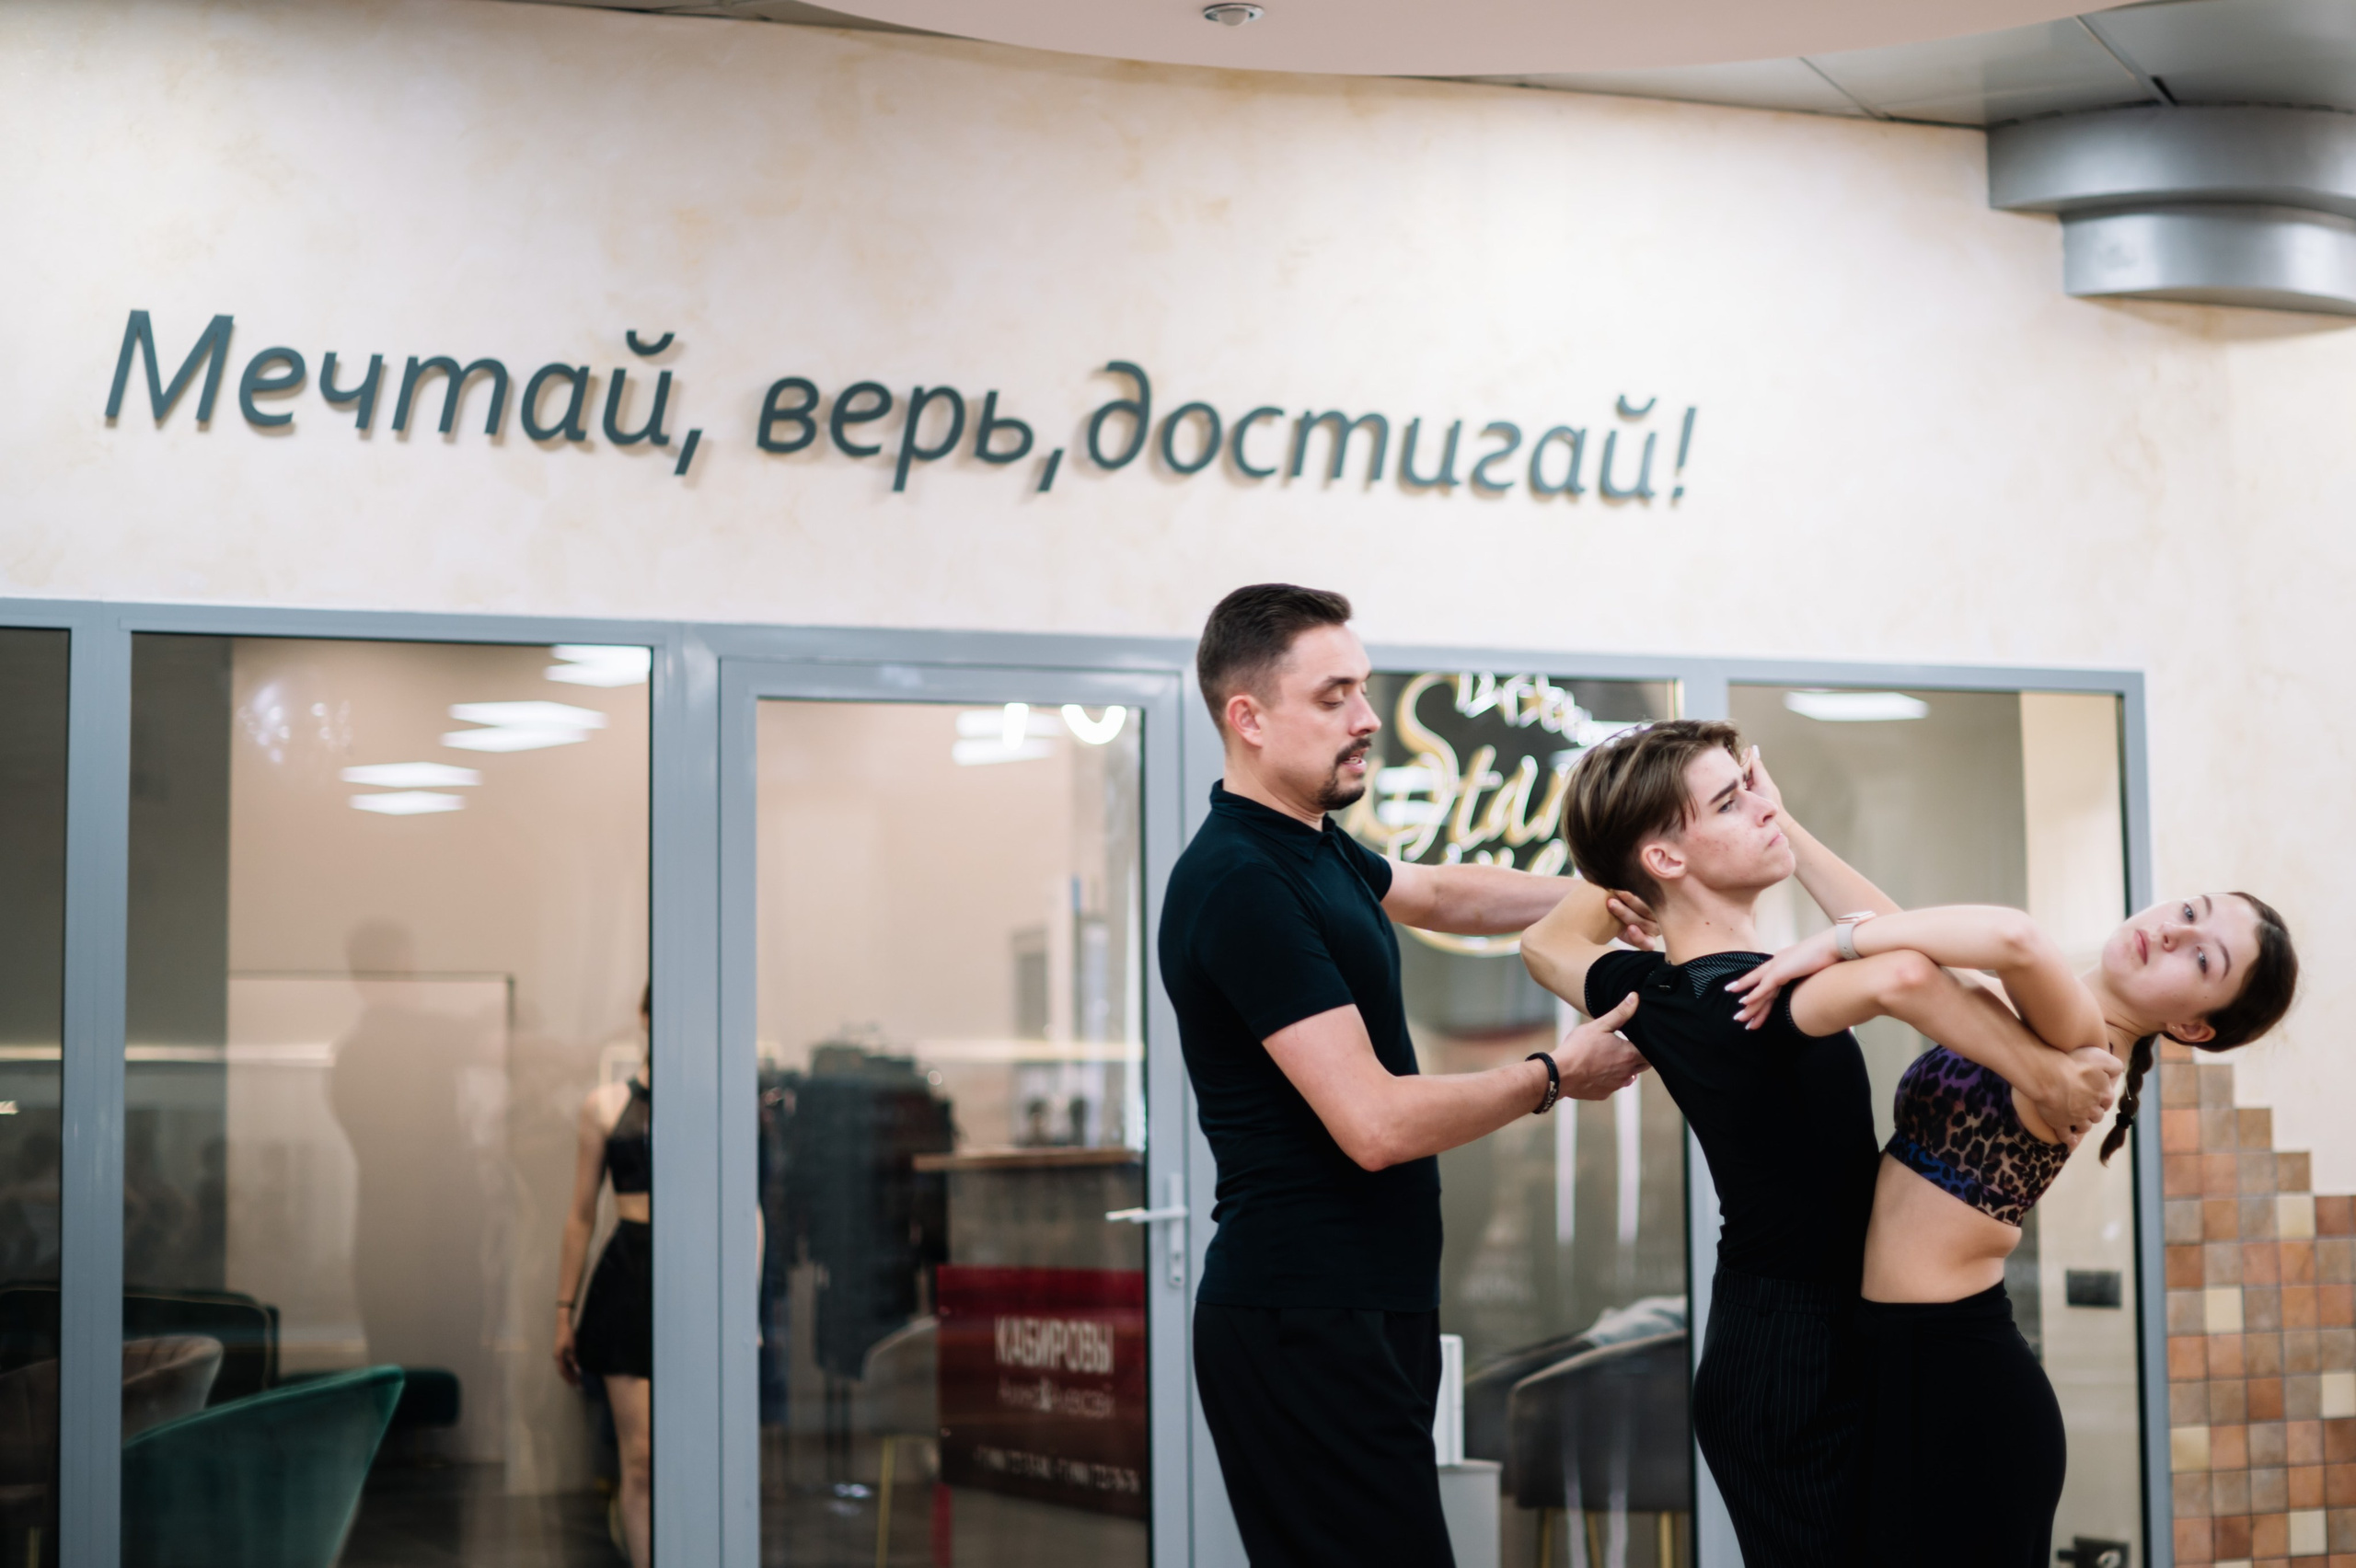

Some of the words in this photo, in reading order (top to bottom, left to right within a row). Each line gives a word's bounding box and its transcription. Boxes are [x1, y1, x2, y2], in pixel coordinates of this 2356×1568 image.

[104, 308, 703, 477] Мечтай,
[755, 375, 1065, 494] верь,
[1086, 359, 1697, 506] достигай!
